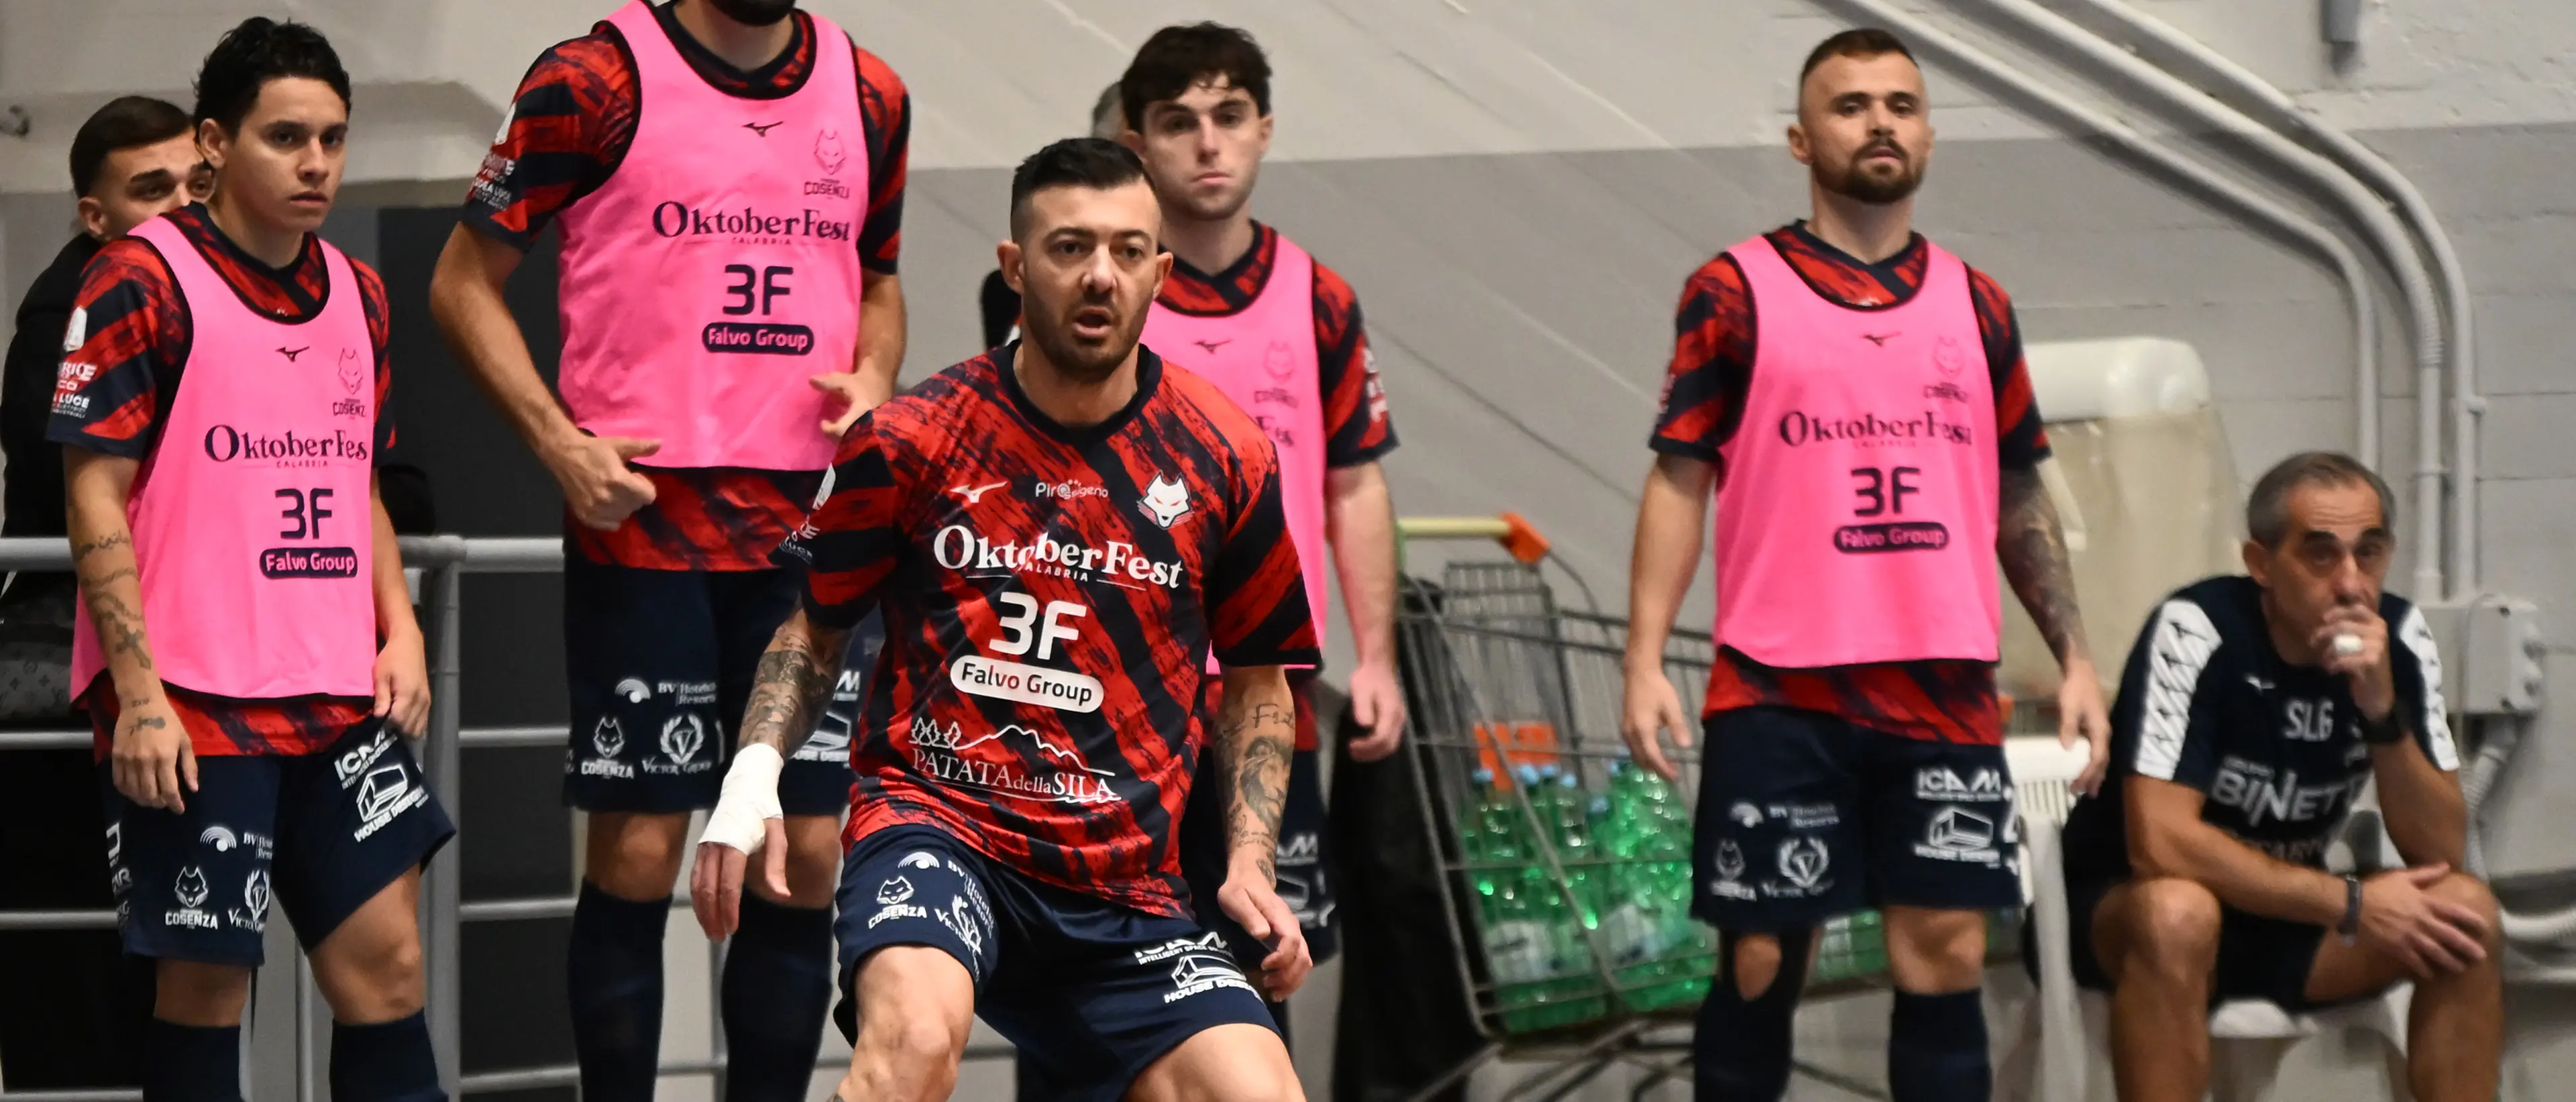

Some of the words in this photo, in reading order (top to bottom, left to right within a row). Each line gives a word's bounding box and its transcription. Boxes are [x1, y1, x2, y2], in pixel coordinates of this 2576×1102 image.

[722, 264, 794, 315] 3F
[708, 327, 751, 346] Falvo
[755, 329, 808, 351] Group
[333, 401, 366, 417] COSENZ
[205, 425, 368, 462] OktoberFes
[276, 460, 329, 468] CALABRIA
[1851, 467, 1921, 517] 3F
[275, 488, 333, 539] 3F
[1889, 527, 1945, 548] Group
[266, 552, 307, 571] Falvo
[310, 553, 355, 575] Group
[934, 525, 1183, 588] OktoberFest
[989, 592, 1087, 660] 3F
[962, 663, 1020, 690] Falvo
[1027, 674, 1092, 706] Group
[1918, 769, 2001, 793] ICAM
[947, 860, 965, 877] BV
[165, 911, 218, 930] COSENZA
[869, 905, 927, 930] COSENZA
[1164, 980, 1214, 1003] HOUSE
